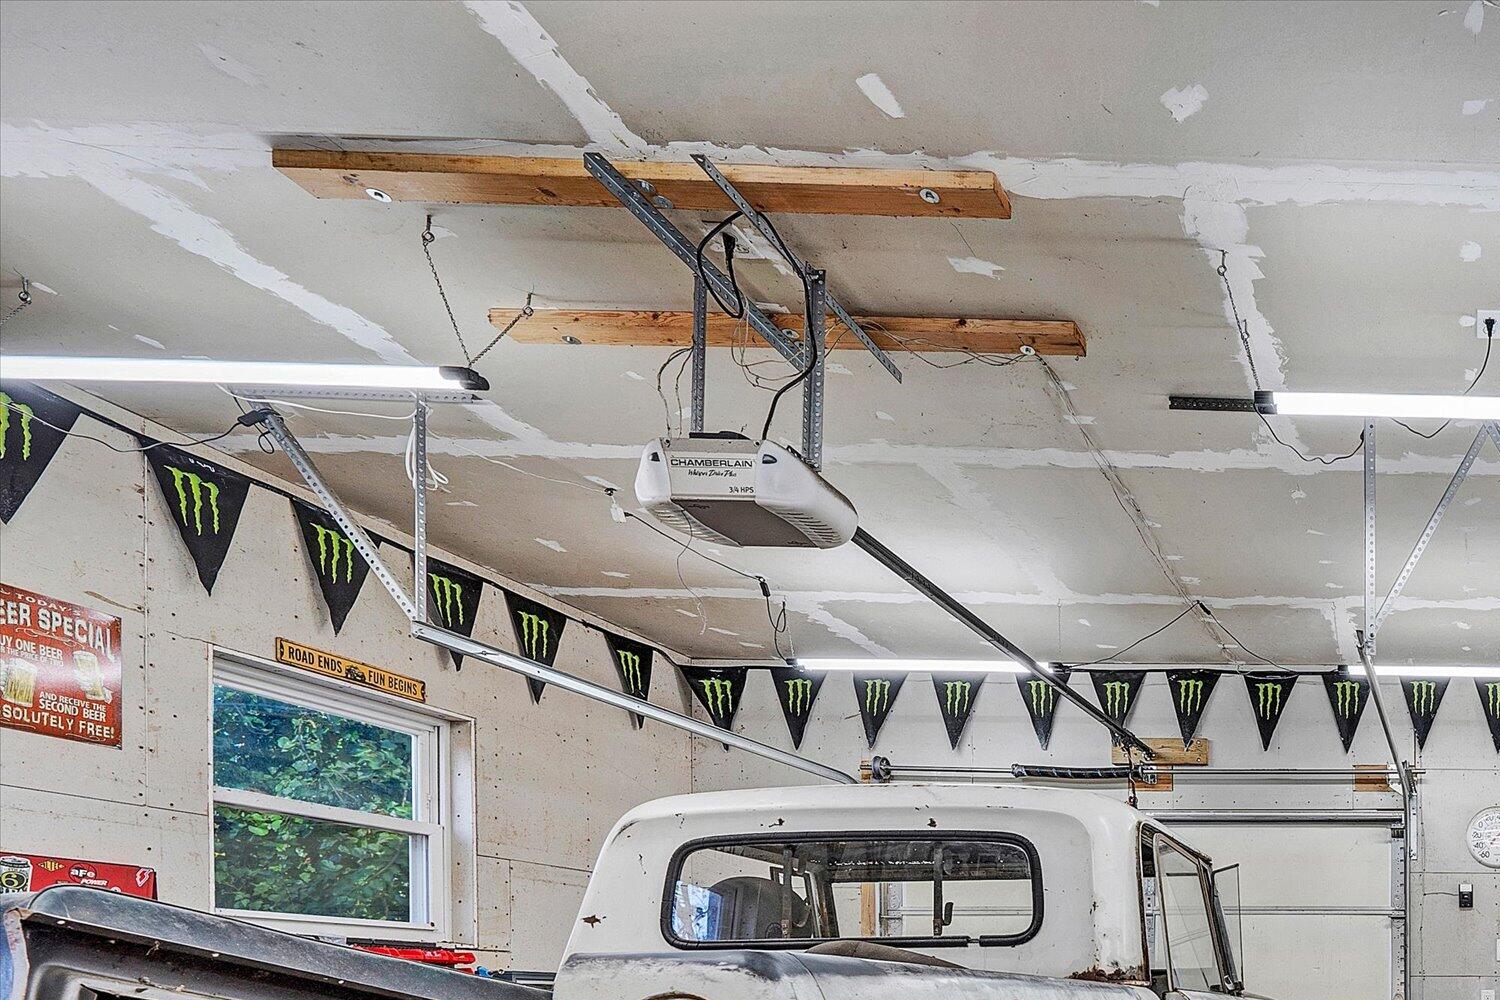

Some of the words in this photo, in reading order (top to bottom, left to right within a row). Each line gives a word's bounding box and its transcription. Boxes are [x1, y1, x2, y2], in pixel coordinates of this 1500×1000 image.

[670, 458, 752, 468] CHAMBERLAIN
[729, 486, 739, 494] 3/4
[740, 486, 754, 494] HPS
[38, 607, 115, 663] SPECIAL
[15, 638, 37, 655] ONE
[39, 644, 63, 662] BEER
[288, 645, 314, 666] ROAD
[317, 655, 342, 674] ENDS
[368, 669, 386, 687] FUN
[388, 676, 418, 697] BEGINS
[39, 691, 57, 701] AND
[58, 695, 90, 709] RECEIVE
[93, 702, 106, 712] THE
[39, 699, 79, 716] SECOND
[82, 707, 106, 722] BEER
[79, 720, 115, 739] FREE!
[70, 867, 96, 878] aFe
[80, 878, 108, 886] POWER
